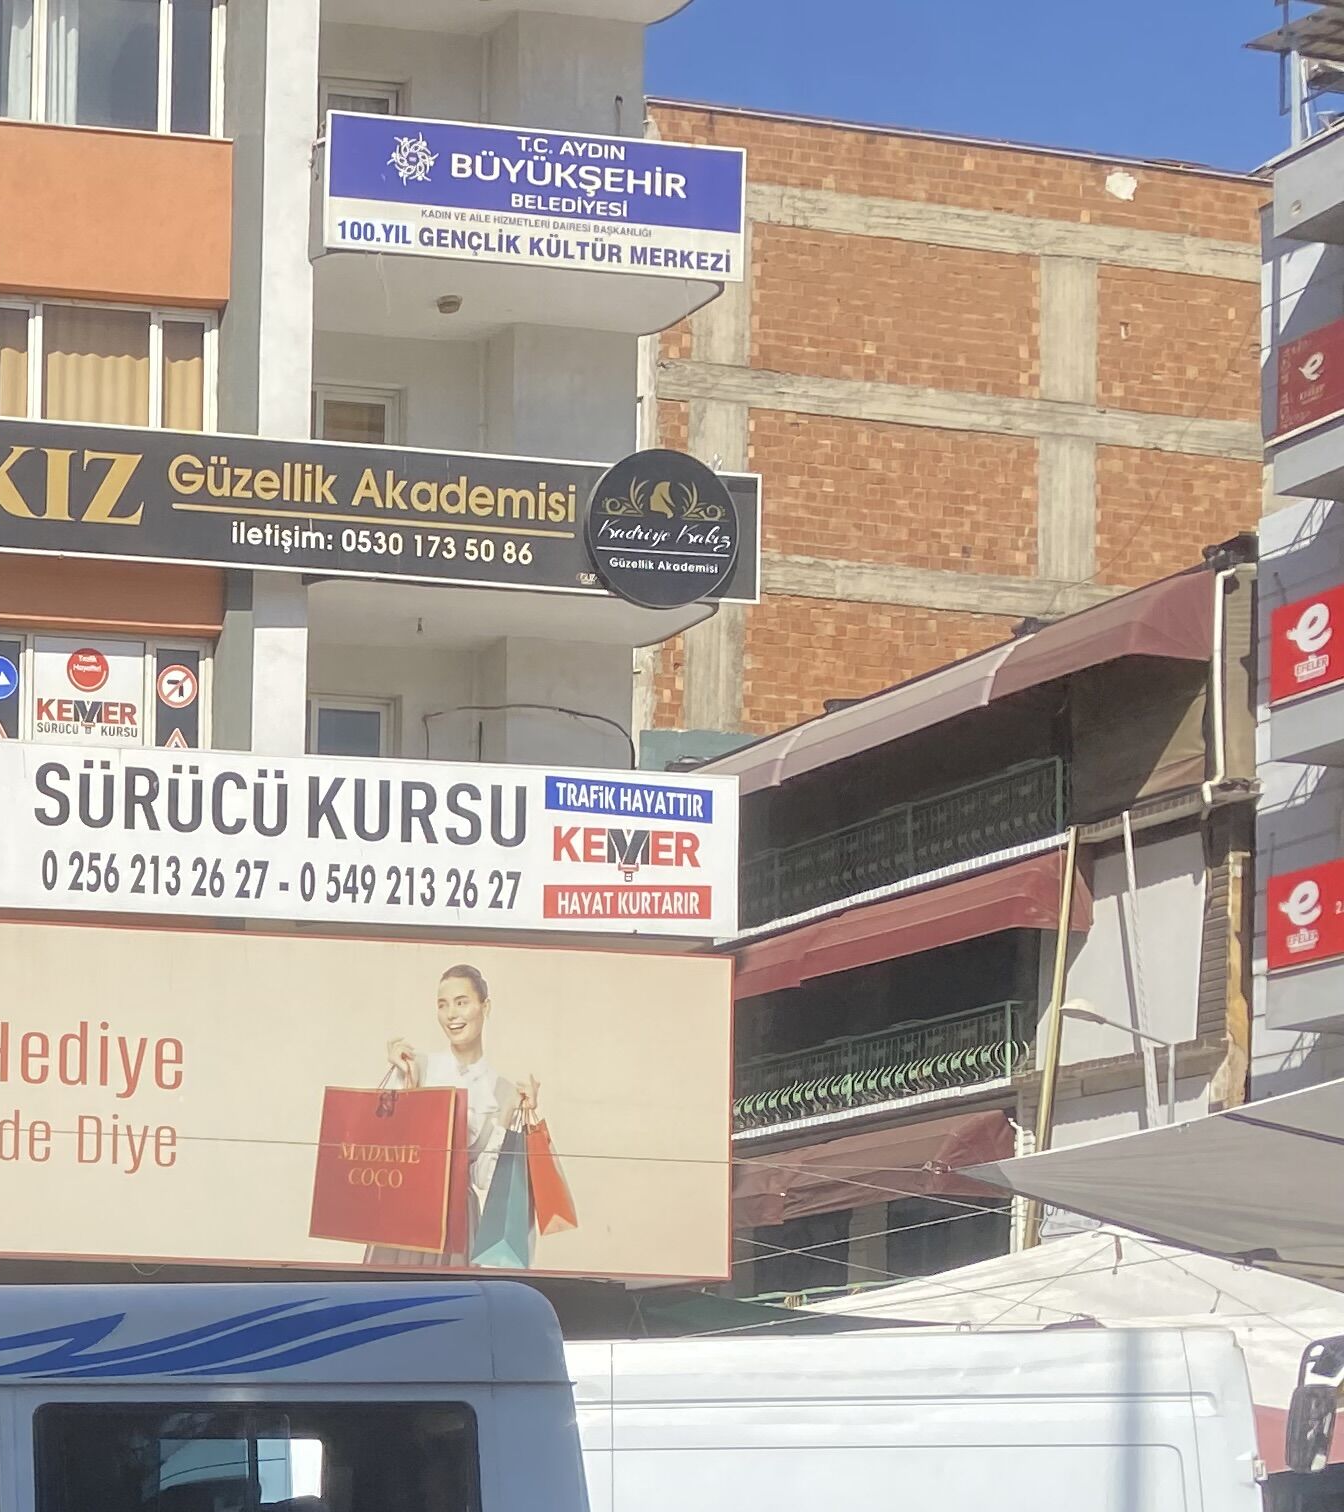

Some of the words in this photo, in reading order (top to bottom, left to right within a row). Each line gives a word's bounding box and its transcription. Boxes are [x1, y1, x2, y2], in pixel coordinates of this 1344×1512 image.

[517, 136, 553, 154] T.C.
[560, 140, 626, 161] AYDIN
[451, 149, 687, 199] BÜYÜKŞEHİR
[421, 209, 452, 221] KADIN
[454, 212, 467, 222] VE
[511, 193, 628, 218] BELEDİYESİ
[337, 220, 411, 245] 100.YIL
[418, 228, 520, 256] GENÇLİK
[529, 233, 622, 264] KÜLTÜR
[630, 248, 732, 274] MERKEZİ
[168, 453, 338, 505] Güzellik
[351, 467, 577, 523] Akademisi
[231, 520, 334, 553] iletişim:
[341, 528, 404, 556] 0530
[413, 532, 457, 560] 173
[464, 536, 496, 563] 50
[502, 541, 534, 566] 86
[609, 556, 655, 571] Güzellik
[657, 560, 719, 575] Akademisi
[36, 698, 138, 725] KEMER
[36, 721, 79, 735] SÜRÜCÜ
[100, 726, 139, 738] KURSU
[34, 760, 289, 838] SÜRÜCÜ
[308, 776, 528, 848] KURSU
[618, 785, 705, 819] HAYATTIR
[552, 825, 701, 868] KEMER
[41, 849, 58, 892] 0
[67, 851, 120, 894] 256
[130, 854, 180, 897] 213
[191, 856, 226, 899] 26
[235, 860, 270, 902] 27
[299, 863, 316, 904] 0
[325, 863, 376, 906] 549
[386, 866, 436, 908] 213
[446, 869, 480, 910] 26
[489, 871, 523, 912] 27
[556, 890, 614, 916] HAYAT
[616, 890, 701, 918] KURTARIR
[76, 1112, 179, 1176] Diye
[337, 1142, 420, 1165] MADAME
[348, 1167, 403, 1189] COCO
